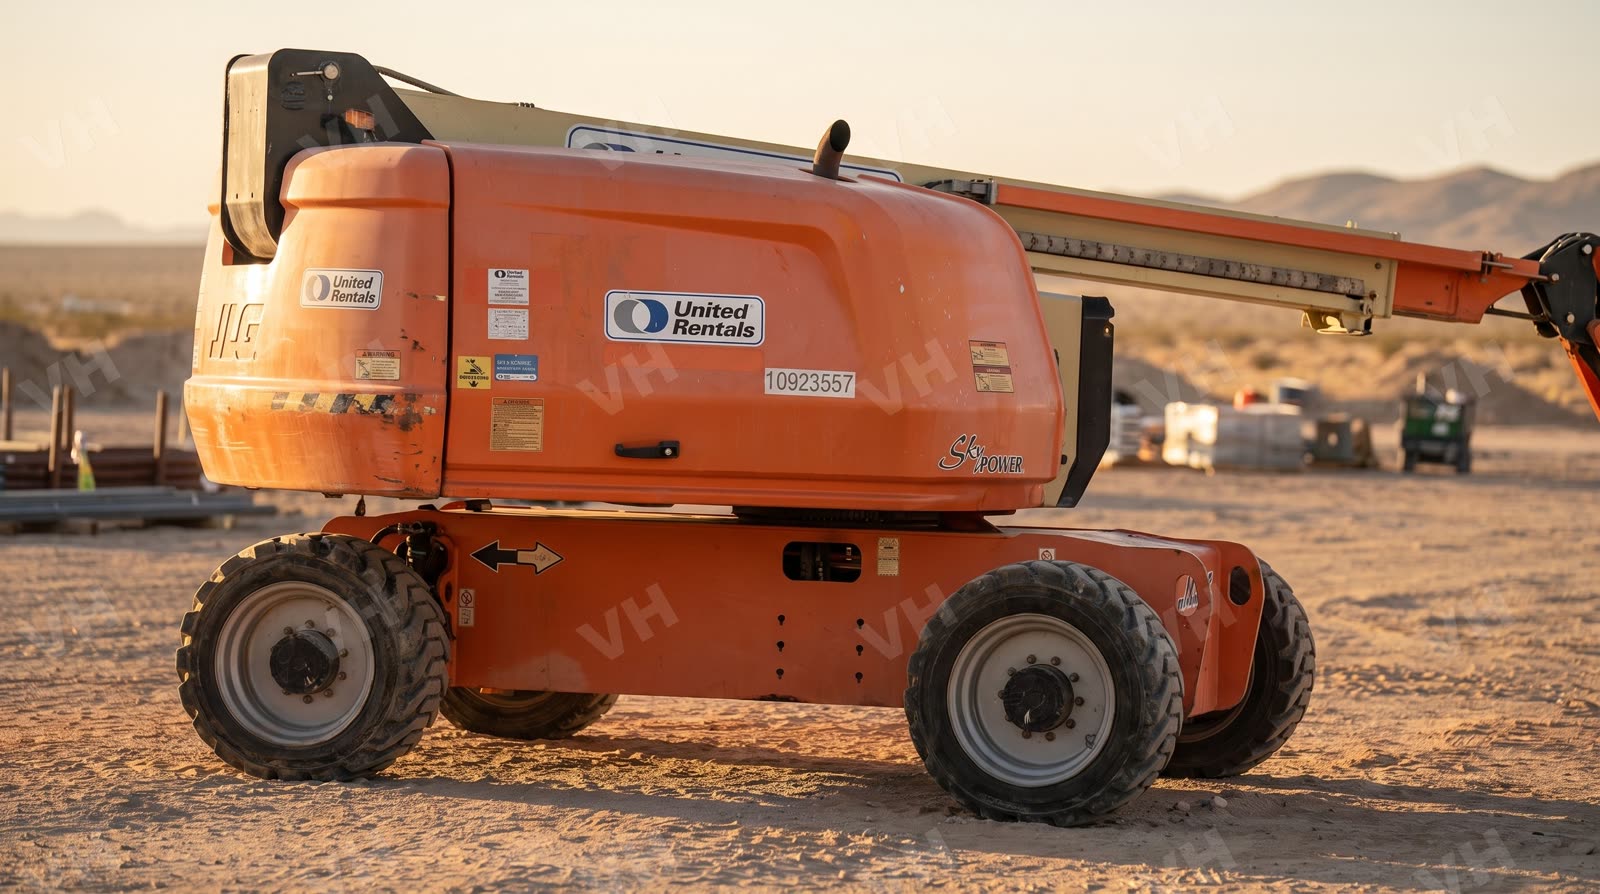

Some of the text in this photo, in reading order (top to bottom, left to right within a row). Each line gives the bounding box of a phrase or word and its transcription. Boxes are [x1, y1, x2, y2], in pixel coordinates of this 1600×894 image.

[333, 275, 374, 289] United
[331, 289, 376, 303] Rentals
[673, 300, 749, 320] United
[672, 319, 755, 338] Rentals
[765, 371, 854, 394] 10923557
[938, 434, 1023, 474] Sky POWER
